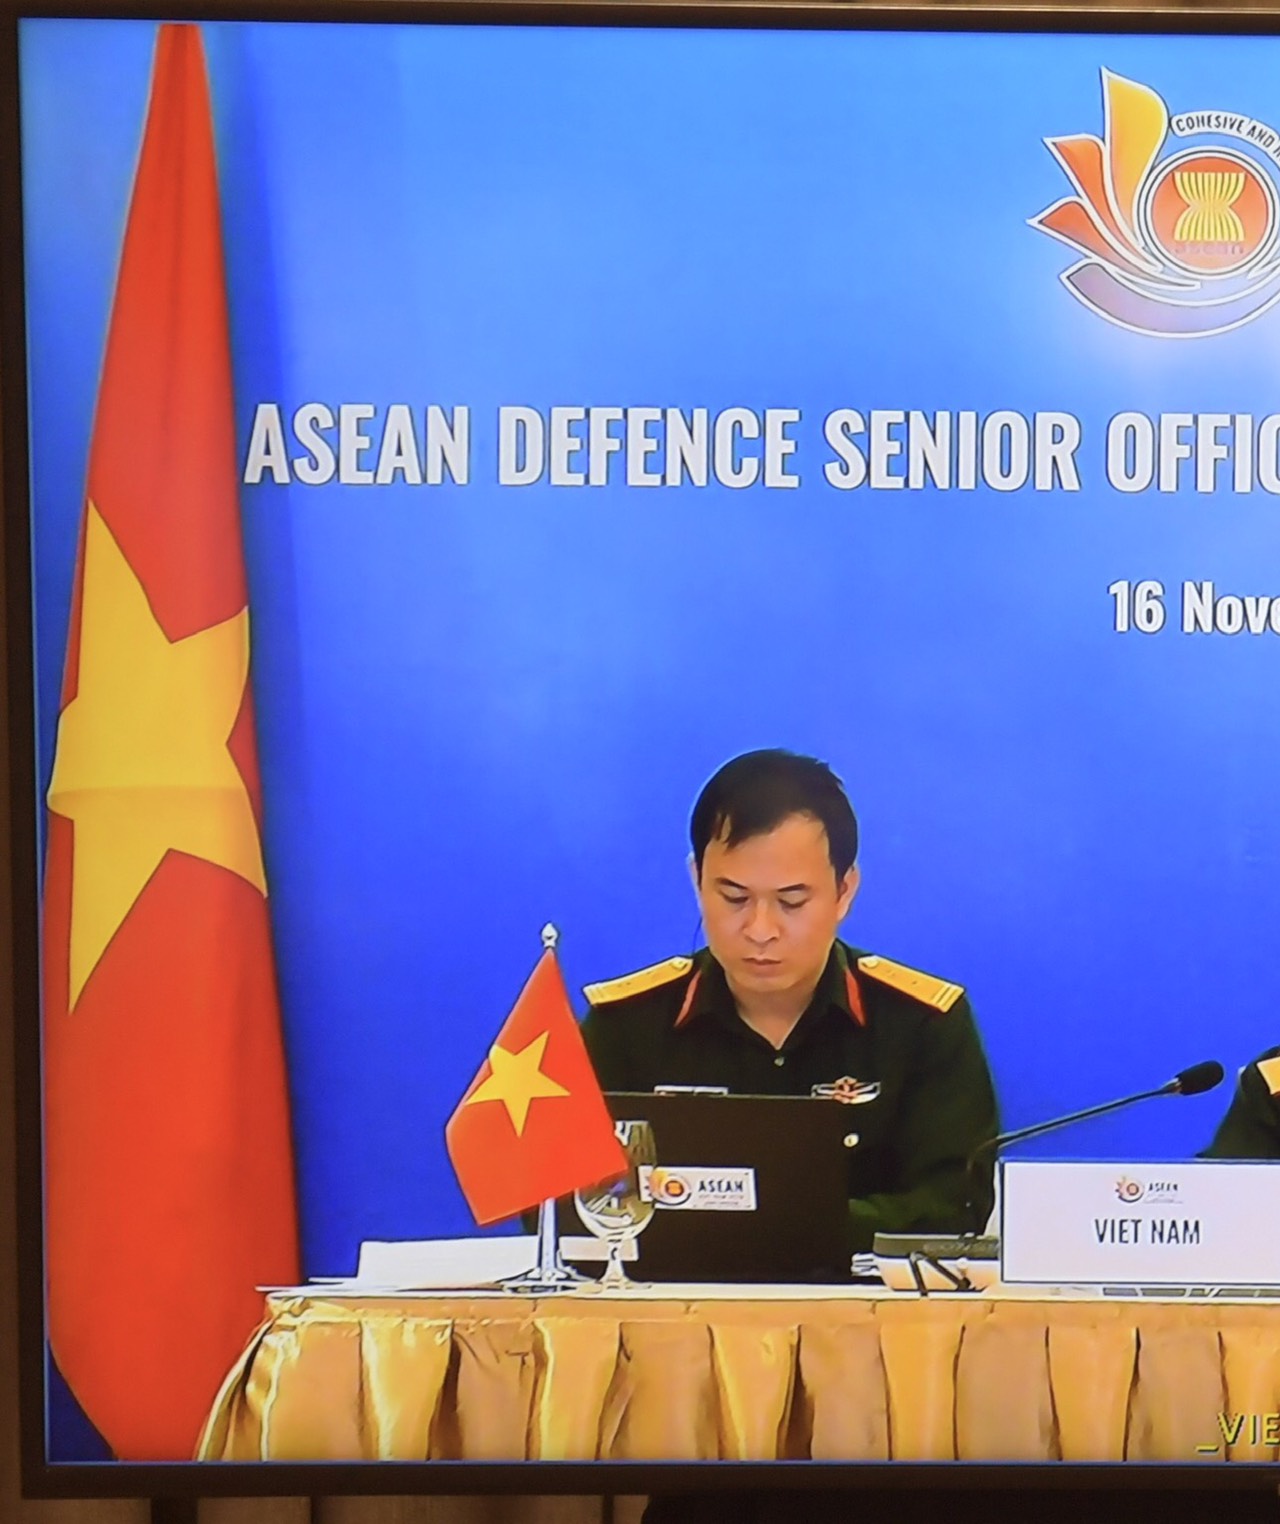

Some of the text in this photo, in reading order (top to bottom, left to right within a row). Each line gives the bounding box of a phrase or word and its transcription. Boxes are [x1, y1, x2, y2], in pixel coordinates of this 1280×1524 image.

[1175, 114, 1245, 134] COHESIVE
[1247, 125, 1275, 149] AND
[244, 403, 468, 485] ASEAN
[499, 406, 799, 488] DEFENCE
[823, 408, 1081, 491] SENIOR
[1108, 580, 1165, 633] 16
[698, 1180, 744, 1193] ASEAN
[1094, 1218, 1200, 1245] VIET NAM
